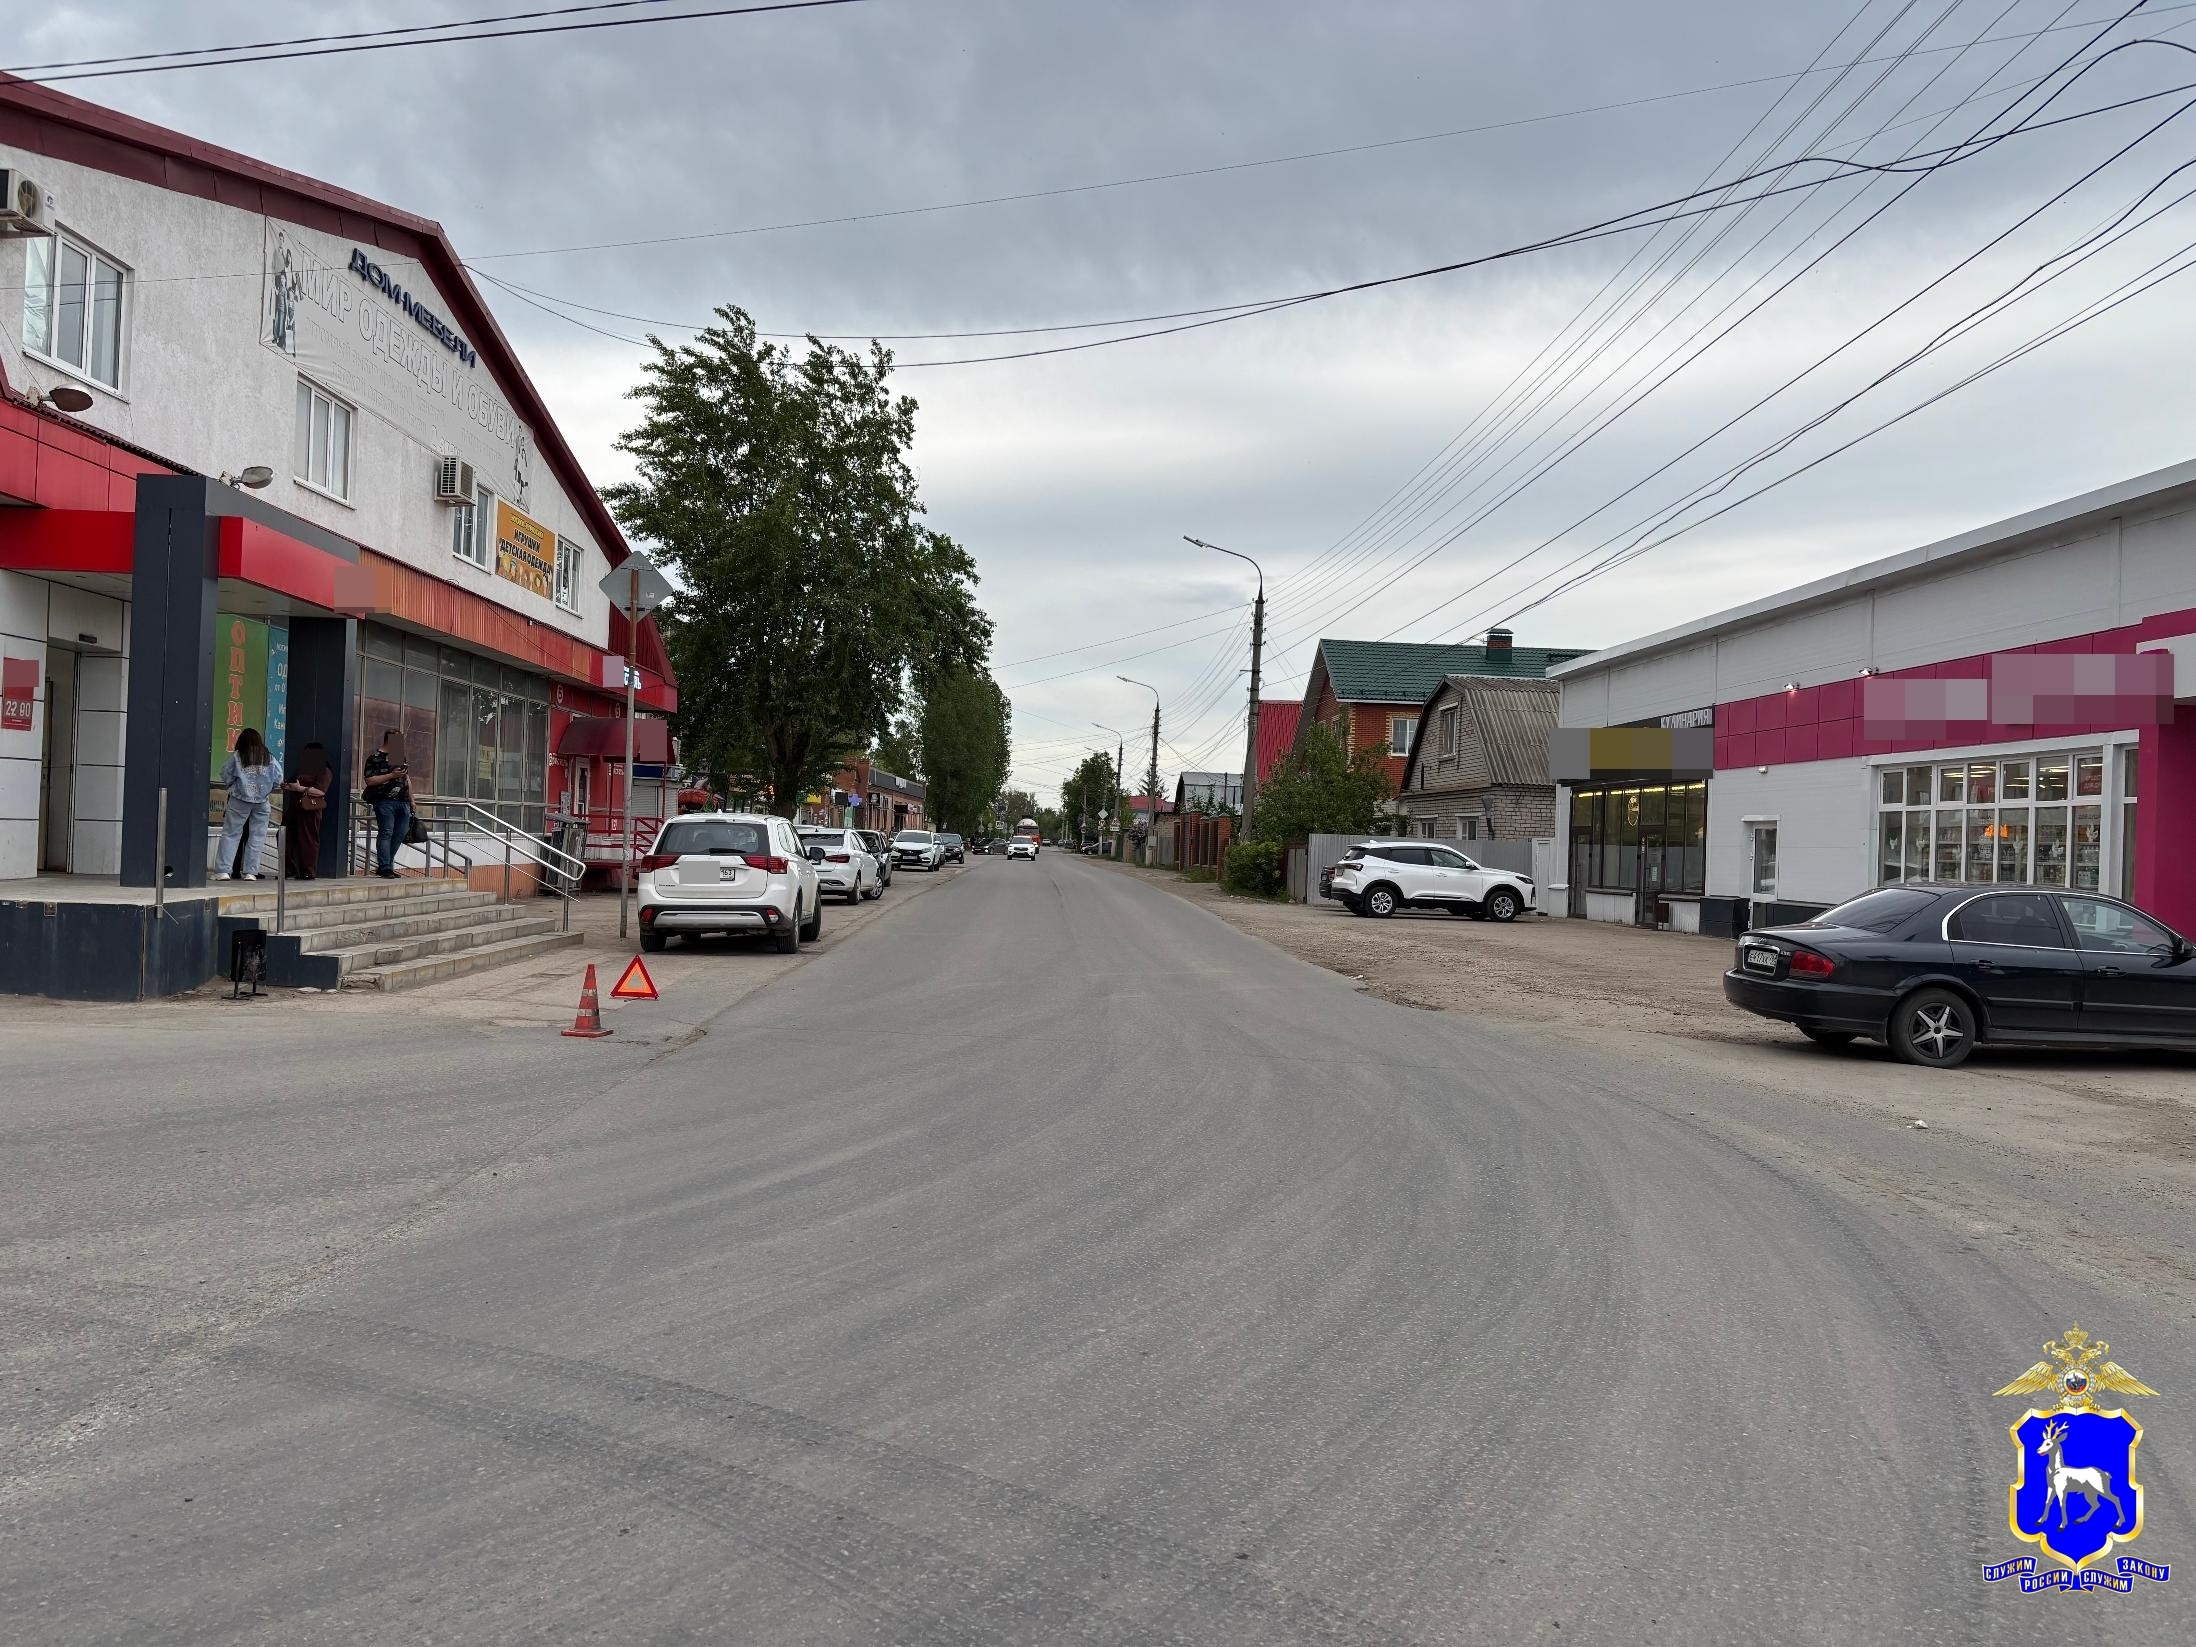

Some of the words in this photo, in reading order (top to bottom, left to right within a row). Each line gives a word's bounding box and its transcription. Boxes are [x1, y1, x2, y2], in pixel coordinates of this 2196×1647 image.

[301, 250, 353, 323] МИР
[359, 298, 447, 399] ОДЕЖДЫ
[451, 369, 464, 410] И
[467, 384, 517, 449] ОБУВИ
[514, 529, 541, 553] ИГРУШКИ
[1661, 709, 1712, 728] КУЛИНАРИЯ
